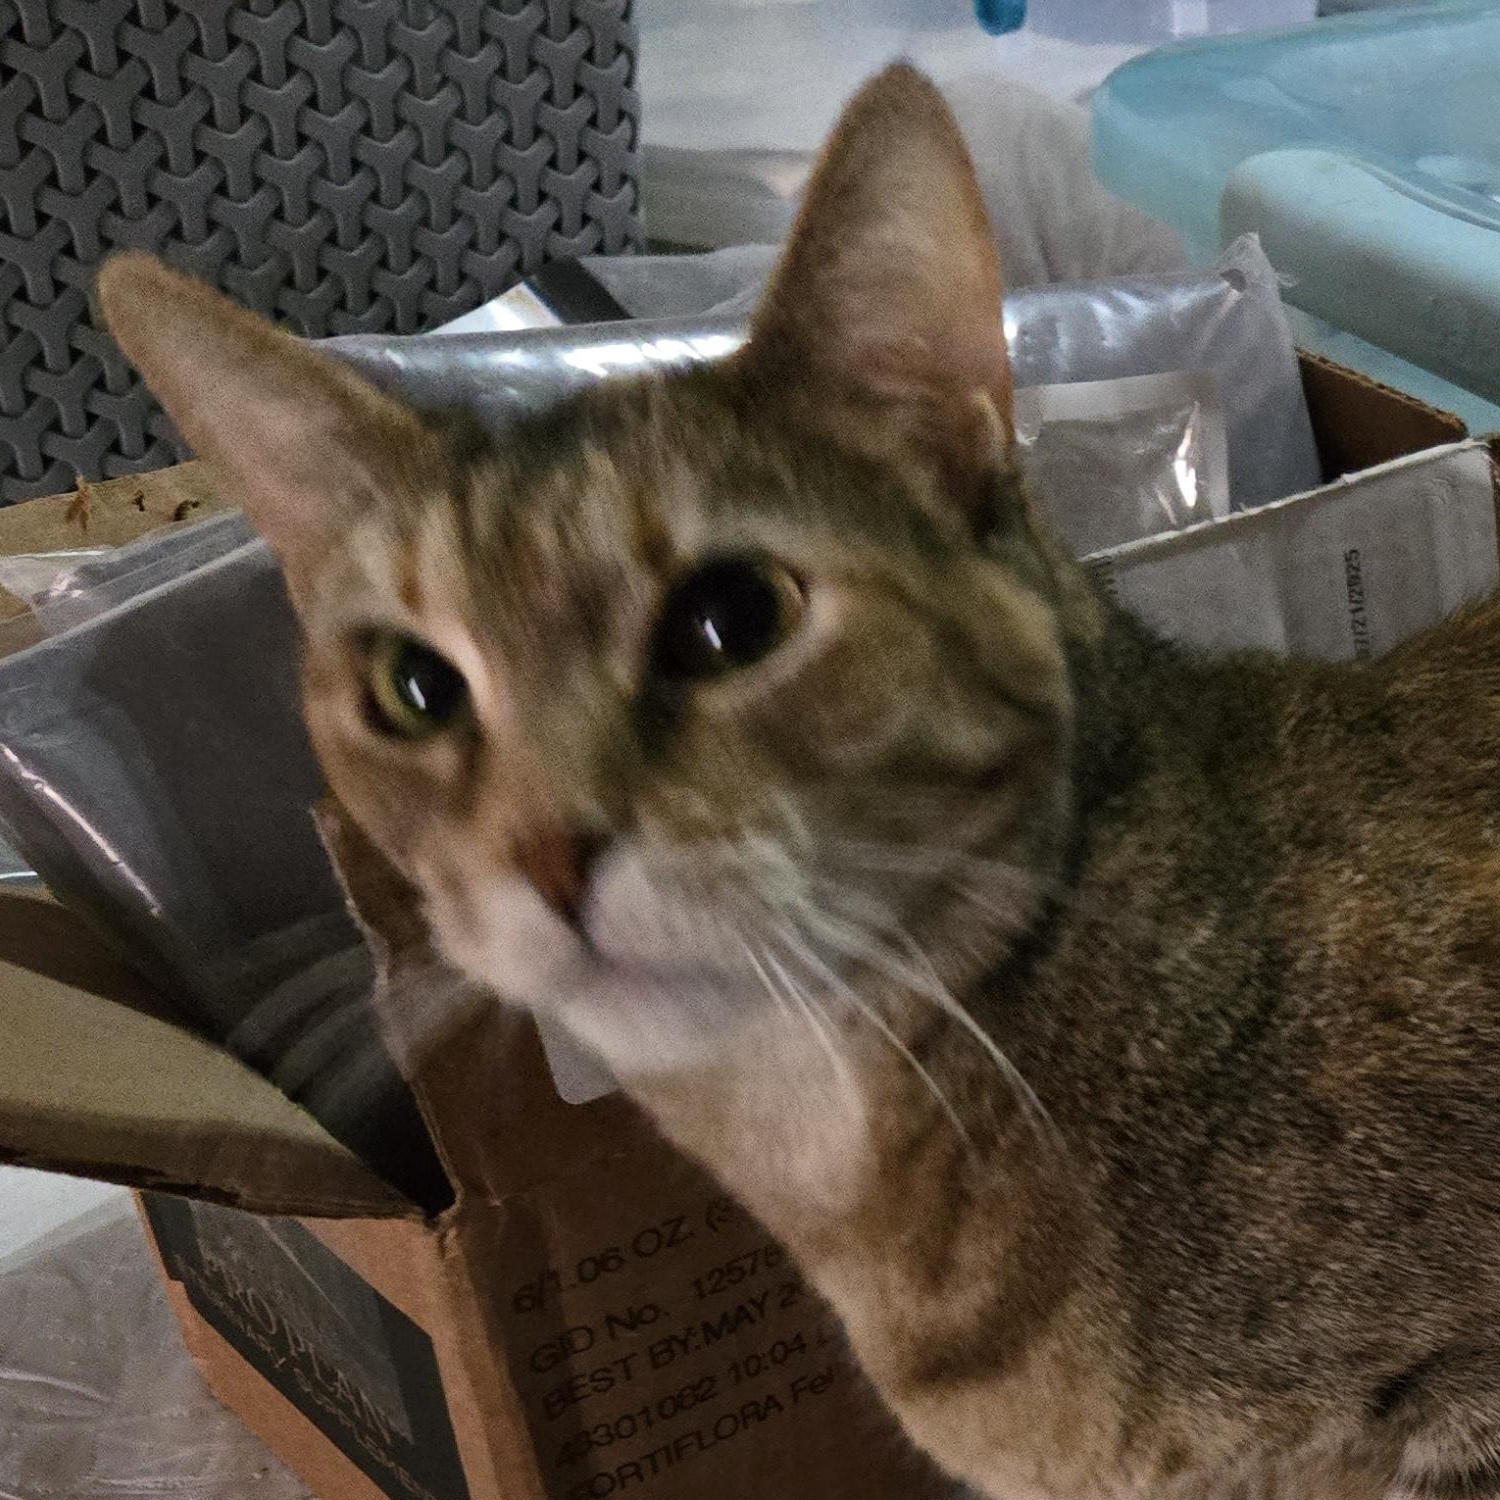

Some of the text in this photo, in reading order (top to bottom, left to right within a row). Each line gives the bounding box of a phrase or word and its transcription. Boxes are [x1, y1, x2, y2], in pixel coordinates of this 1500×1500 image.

[529, 1325, 595, 1373] GID
[605, 1303, 670, 1340] No.
[542, 1352, 637, 1421] BEST
